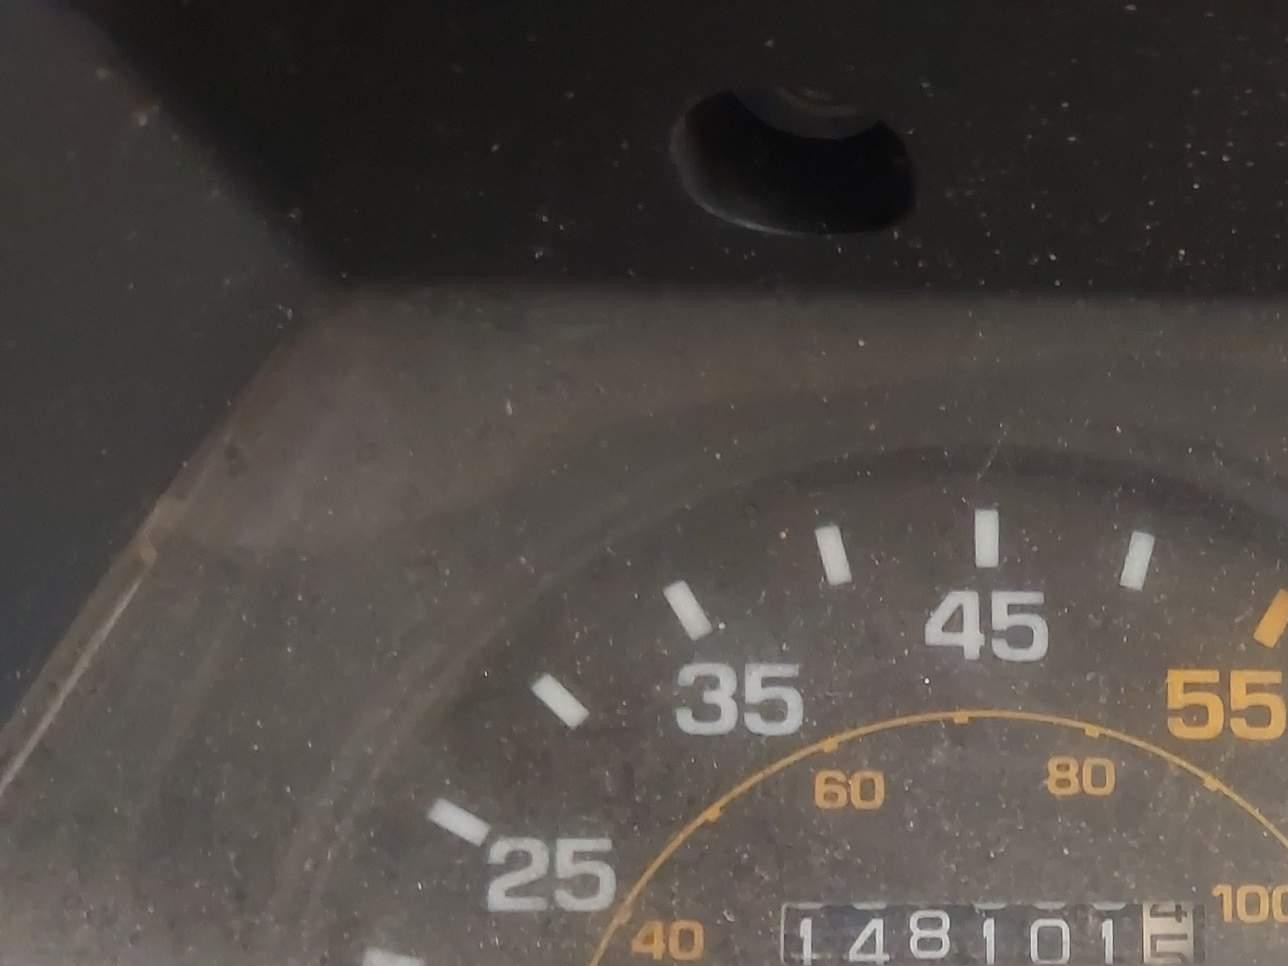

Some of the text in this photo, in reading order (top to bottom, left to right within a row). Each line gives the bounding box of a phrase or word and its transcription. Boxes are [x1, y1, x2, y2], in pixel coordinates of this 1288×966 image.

[925, 590, 1049, 662] 45
[675, 662, 804, 736] 35
[1166, 669, 1287, 740] 55
[814, 769, 886, 811] 60
[1046, 757, 1116, 797] 80
[487, 837, 617, 913] 25
[631, 920, 705, 962] 40
